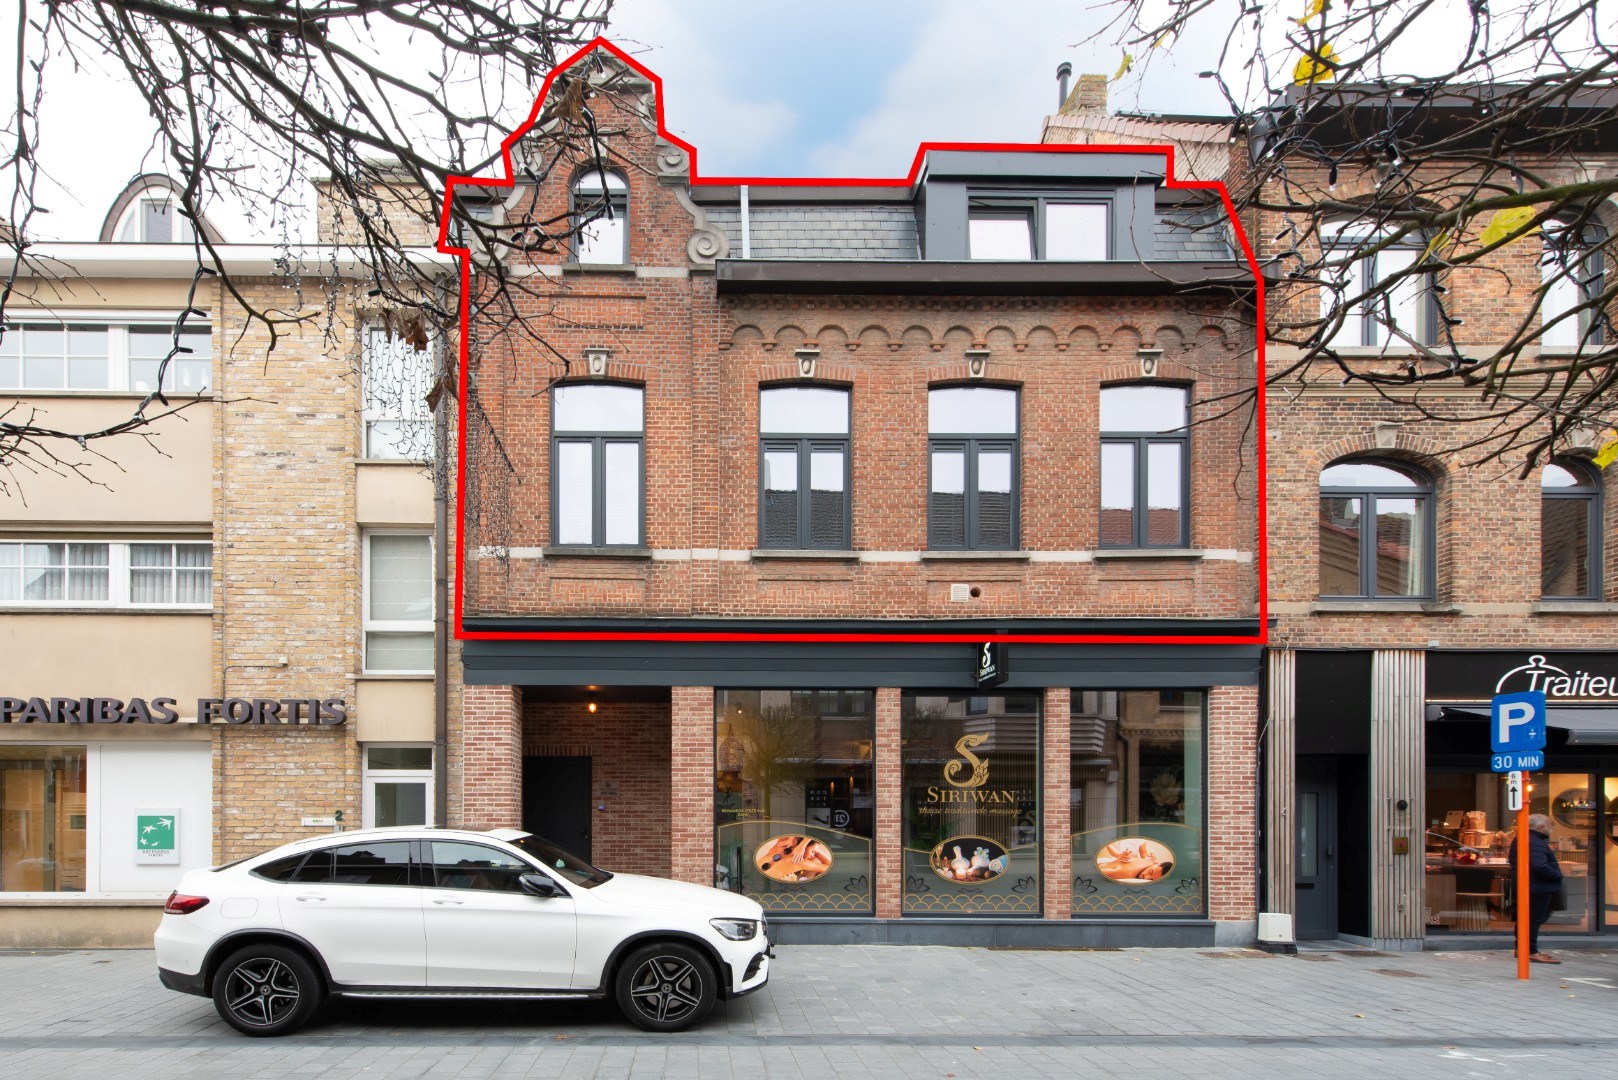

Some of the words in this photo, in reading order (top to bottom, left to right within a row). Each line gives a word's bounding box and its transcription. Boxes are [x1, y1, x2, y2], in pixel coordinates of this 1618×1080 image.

[1525, 670, 1618, 696] Traiteu
[0, 697, 179, 724] PARIBAS
[197, 698, 347, 725] FORTIS
[1498, 701, 1536, 744] P
[1494, 755, 1513, 769] 30
[1517, 755, 1540, 768] MIN
[927, 786, 1017, 804] SIRIWAN
[334, 810, 344, 821] 2
